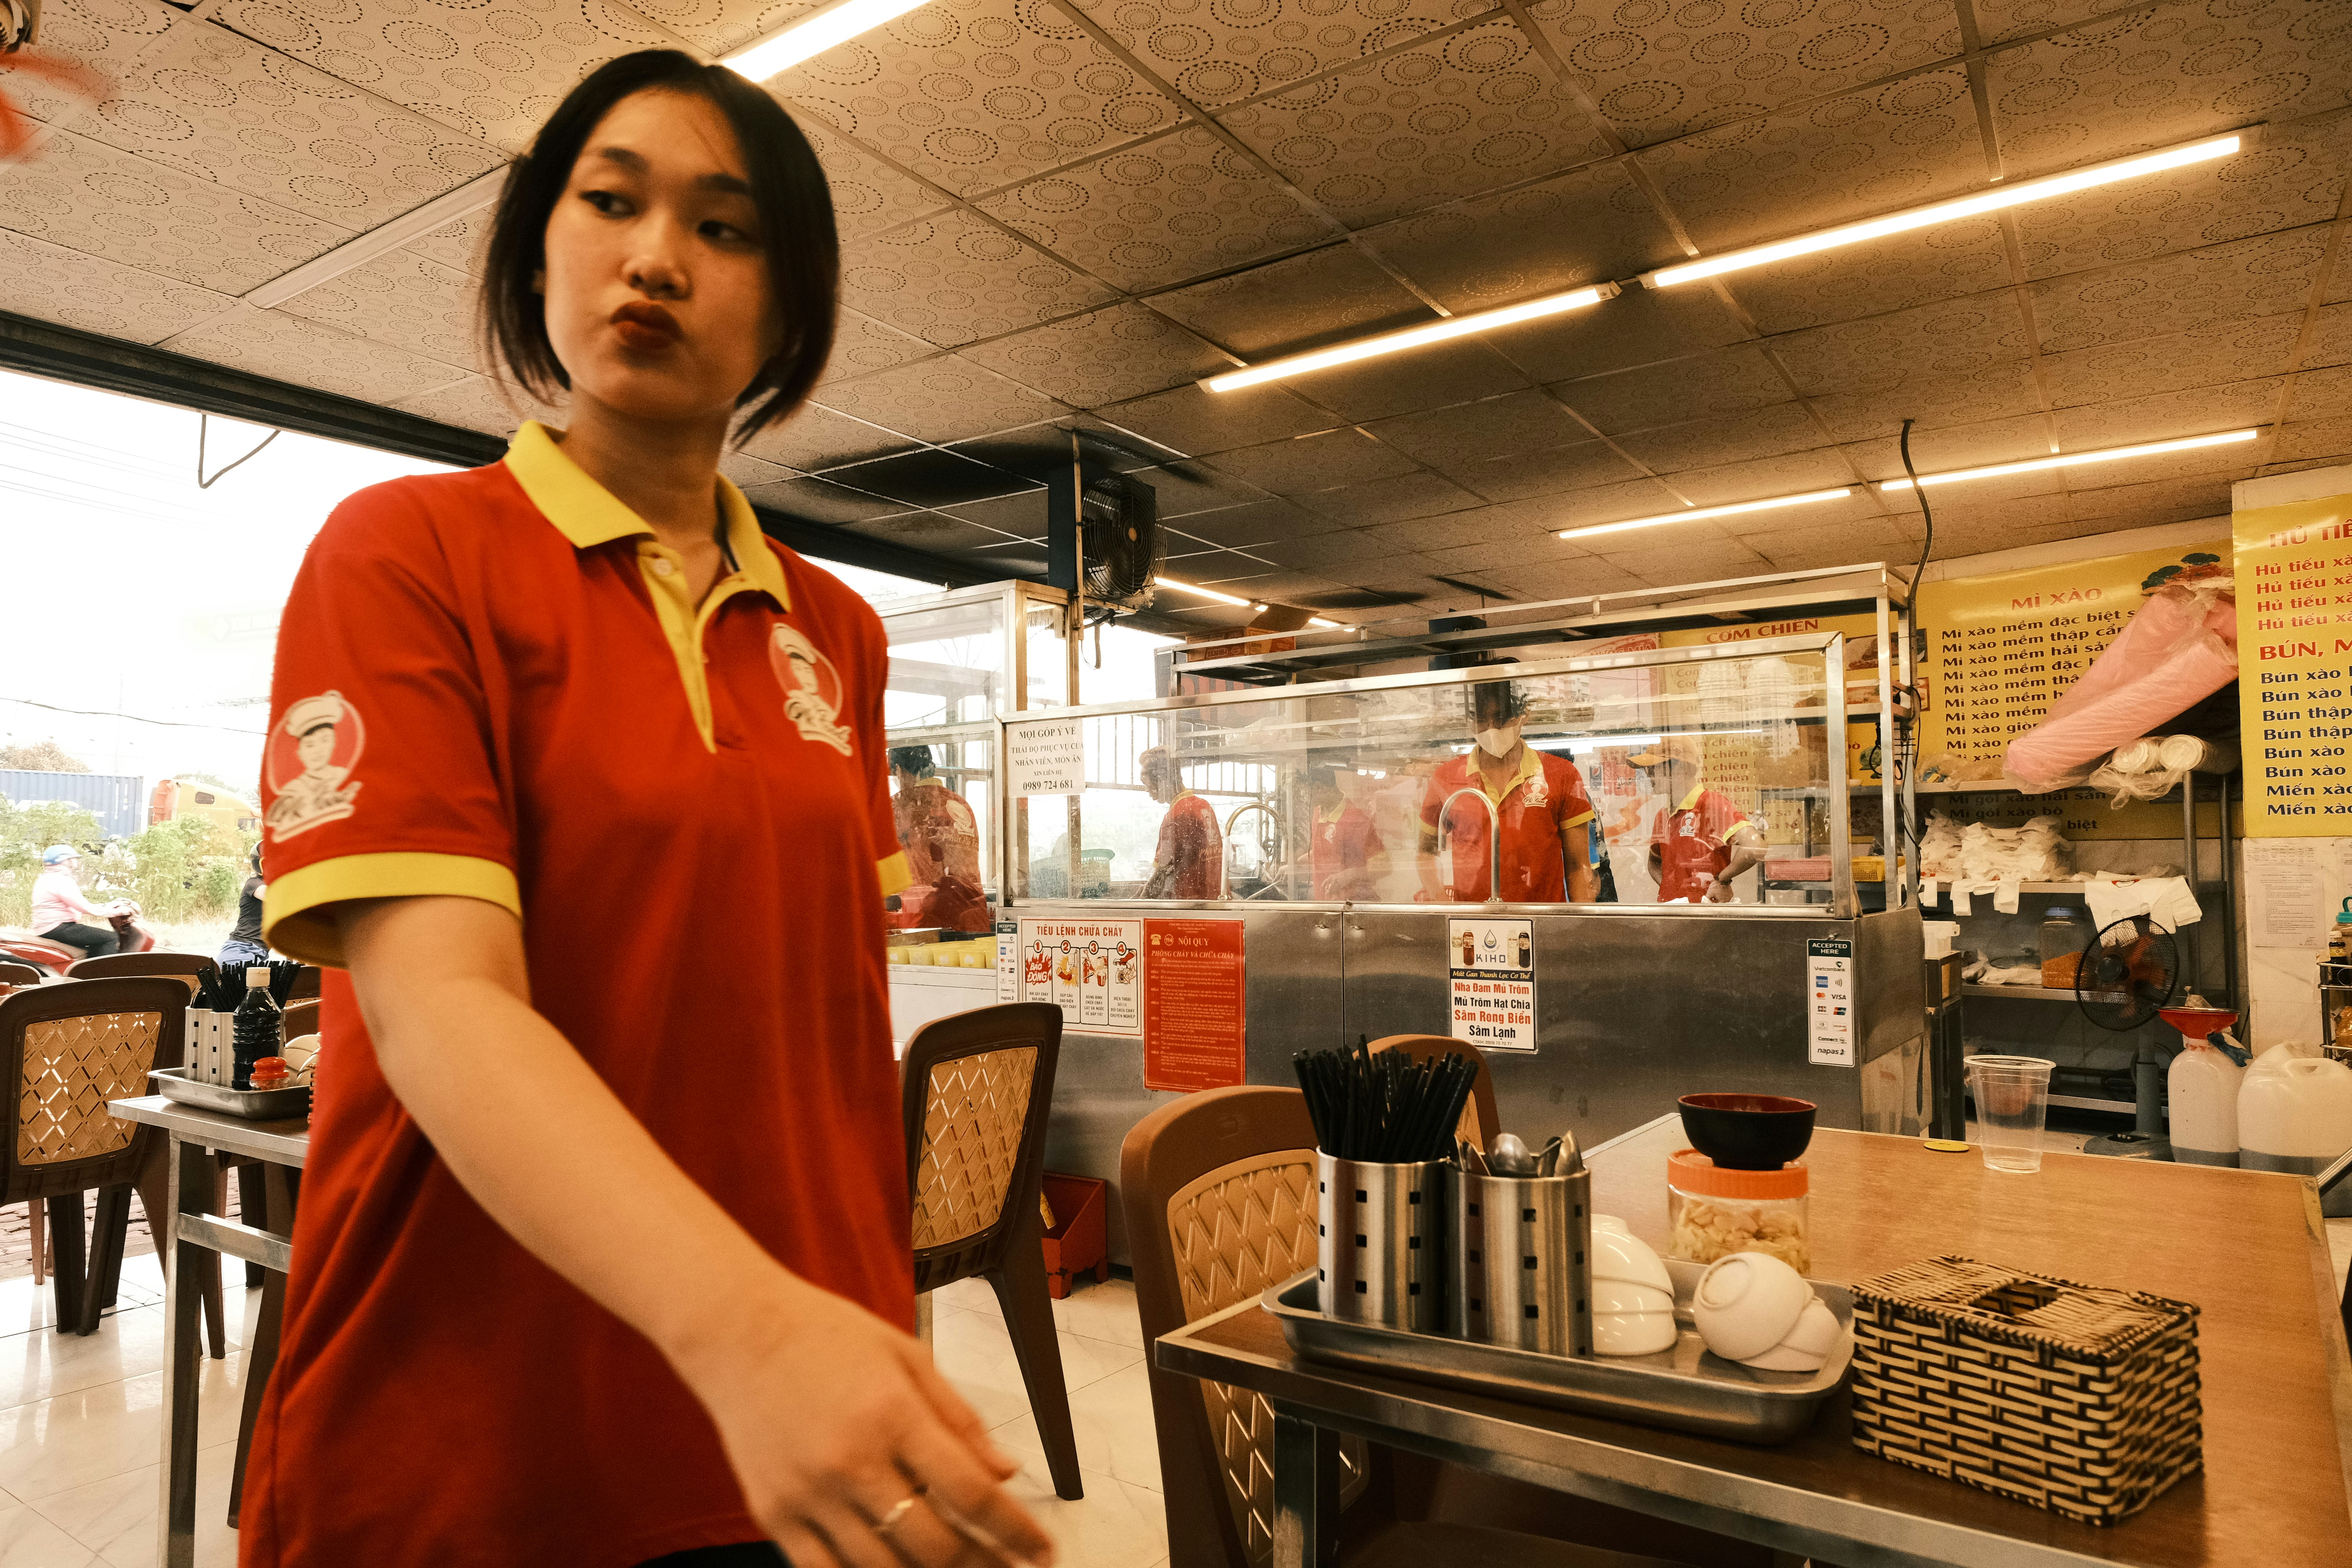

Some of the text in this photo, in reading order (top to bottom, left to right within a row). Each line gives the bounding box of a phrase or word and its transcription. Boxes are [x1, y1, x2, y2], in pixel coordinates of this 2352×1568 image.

[2256, 554, 2352, 576] Hủ tiếu xà
[2257, 573, 2352, 594] Hủ tiếu xà
[2012, 588, 2102, 610] MÌ XÀO
[2257, 594, 2326, 612] Hủ tiếu
[1942, 629, 1962, 639] Mì
[1968, 627, 1996, 637] xào
[2003, 620, 2043, 632] mềm
[2050, 617, 2080, 627] đặc
[2087, 611, 2121, 622] biệt
[2259, 613, 2327, 630] Hủ tiếu
[1706, 628, 1750, 643] CƠM
[1943, 631, 2089, 653] Mì xào mềm thập
[1943, 645, 2078, 667] Mì xào mềm hải
[2260, 640, 2323, 660] BÚN,
[1944, 671, 1963, 681] Mì
[1969, 669, 1998, 678] xào
[2004, 663, 2045, 675] mềm
[2052, 660, 2082, 671] đặc
[2261, 669, 2341, 684] Bún xào
[1945, 677, 2046, 695] Mì xào mềm
[1945, 699, 1965, 708] Mì
[1971, 697, 1999, 706] xào
[2006, 692, 2046, 703] mềm
[2262, 688, 2342, 703] Bún xào
[1946, 706, 2047, 722] Mì xào mềm
[2263, 709, 2300, 721] Bún
[1019, 724, 1076, 740] MỌI GÓP Ý VỀ
[1946, 726, 1966, 736] Mì
[1972, 725, 2001, 734] xào
[2264, 729, 2301, 740] Bún
[1029, 745, 1038, 753] ĐỘ
[1040, 744, 1058, 753] PHỤC
[1071, 741, 1084, 749] CỦA
[1947, 740, 1966, 750] Mì
[1972, 739, 2001, 748] xào
[1712, 750, 1748, 759] chiên
[2265, 745, 2345, 759] Bún xào
[1015, 757, 1034, 766] NHÂN
[1035, 756, 1053, 765] VIÊN,
[1055, 755, 1070, 764] MÓN
[1713, 762, 1748, 771] chiên
[1713, 773, 1749, 782] chiên
[2266, 765, 2346, 778] Bún xào
[1023, 779, 1073, 791] 0989 724 681
[2267, 783, 2315, 796] Miến
[2006, 807, 2035, 816] xào
[2043, 806, 2063, 815] bò
[2268, 802, 2315, 815] Miến
[2067, 820, 2098, 831] biệt
[1037, 924, 1122, 937] TIÊU LỆNH CHỮA CHÁY
[1035, 942, 1040, 951] 1
[1063, 942, 1069, 951] 2
[1091, 943, 1096, 952] 3
[1178, 936, 1209, 947] NỘI QUY
[1118, 944, 1125, 953] 4
[1476, 954, 1506, 963] KIHO
[1455, 982, 1529, 994] Nha Đam Mủ Trôm
[1455, 996, 1530, 1011] Mủ Trôm Hạt Chia
[1455, 1010, 1531, 1024] Sâm Rong Biển
[1469, 1025, 1516, 1040] Sâm Lạnh
